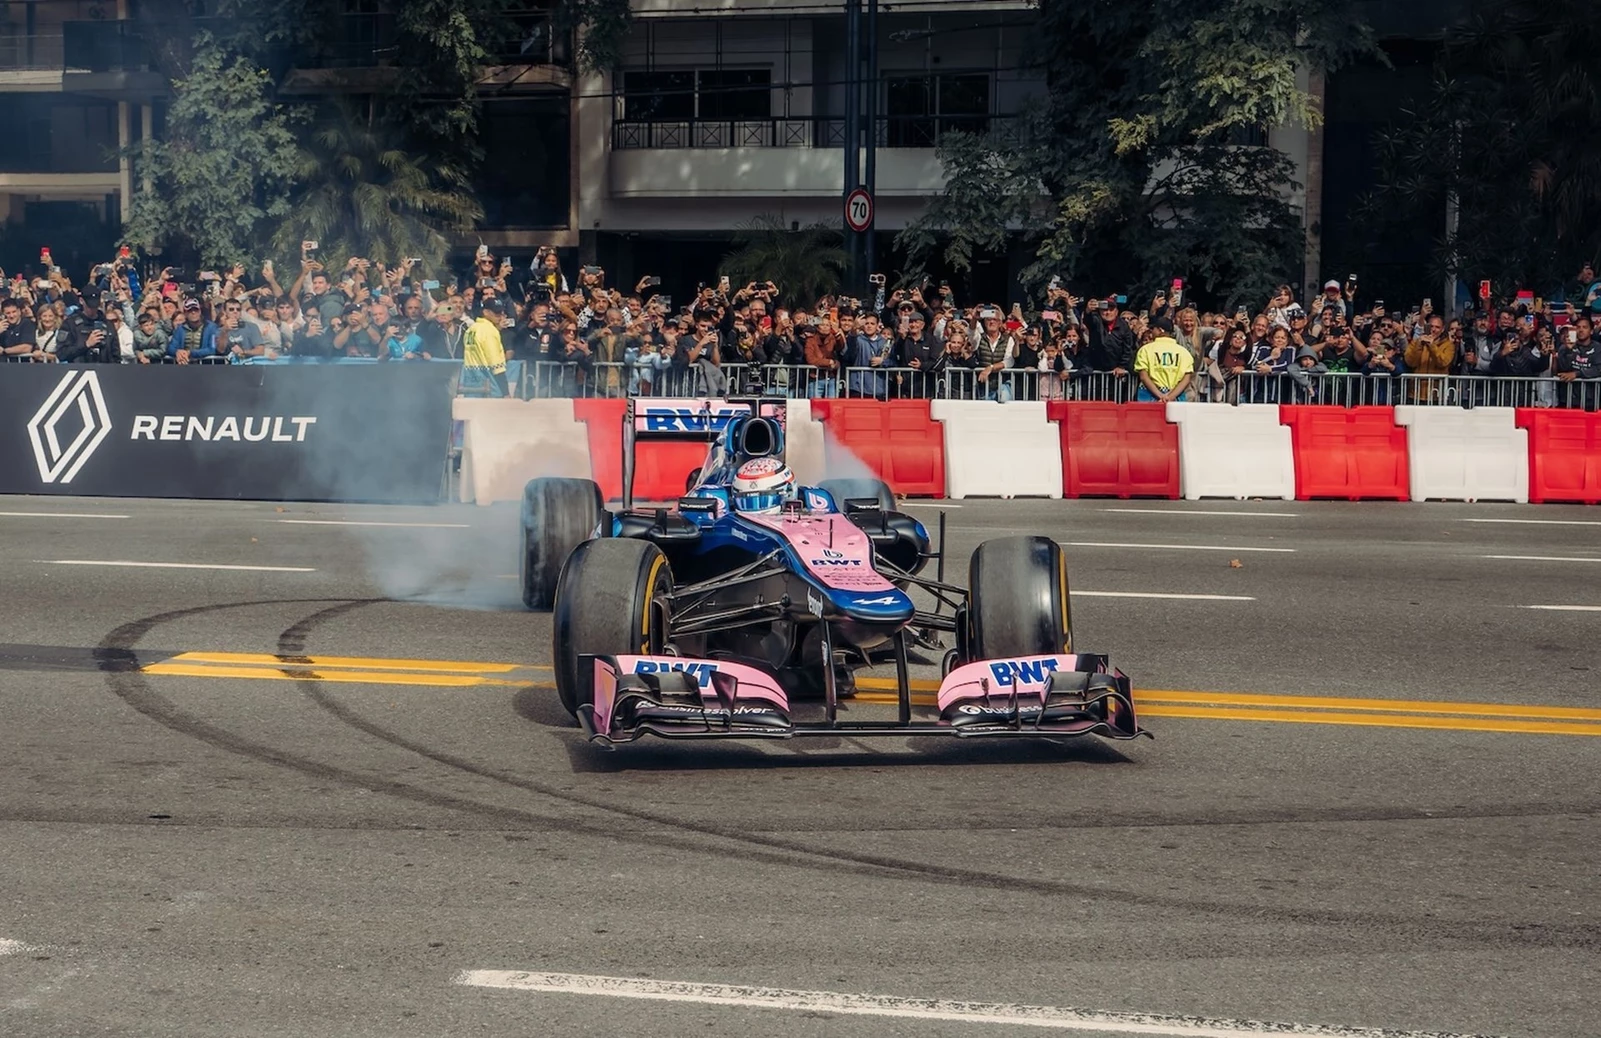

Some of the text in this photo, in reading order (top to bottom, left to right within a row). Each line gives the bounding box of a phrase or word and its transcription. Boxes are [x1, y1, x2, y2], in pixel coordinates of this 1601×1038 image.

[852, 201, 867, 218] 70
[130, 415, 317, 442] RENAULT
[646, 408, 752, 431] BW
